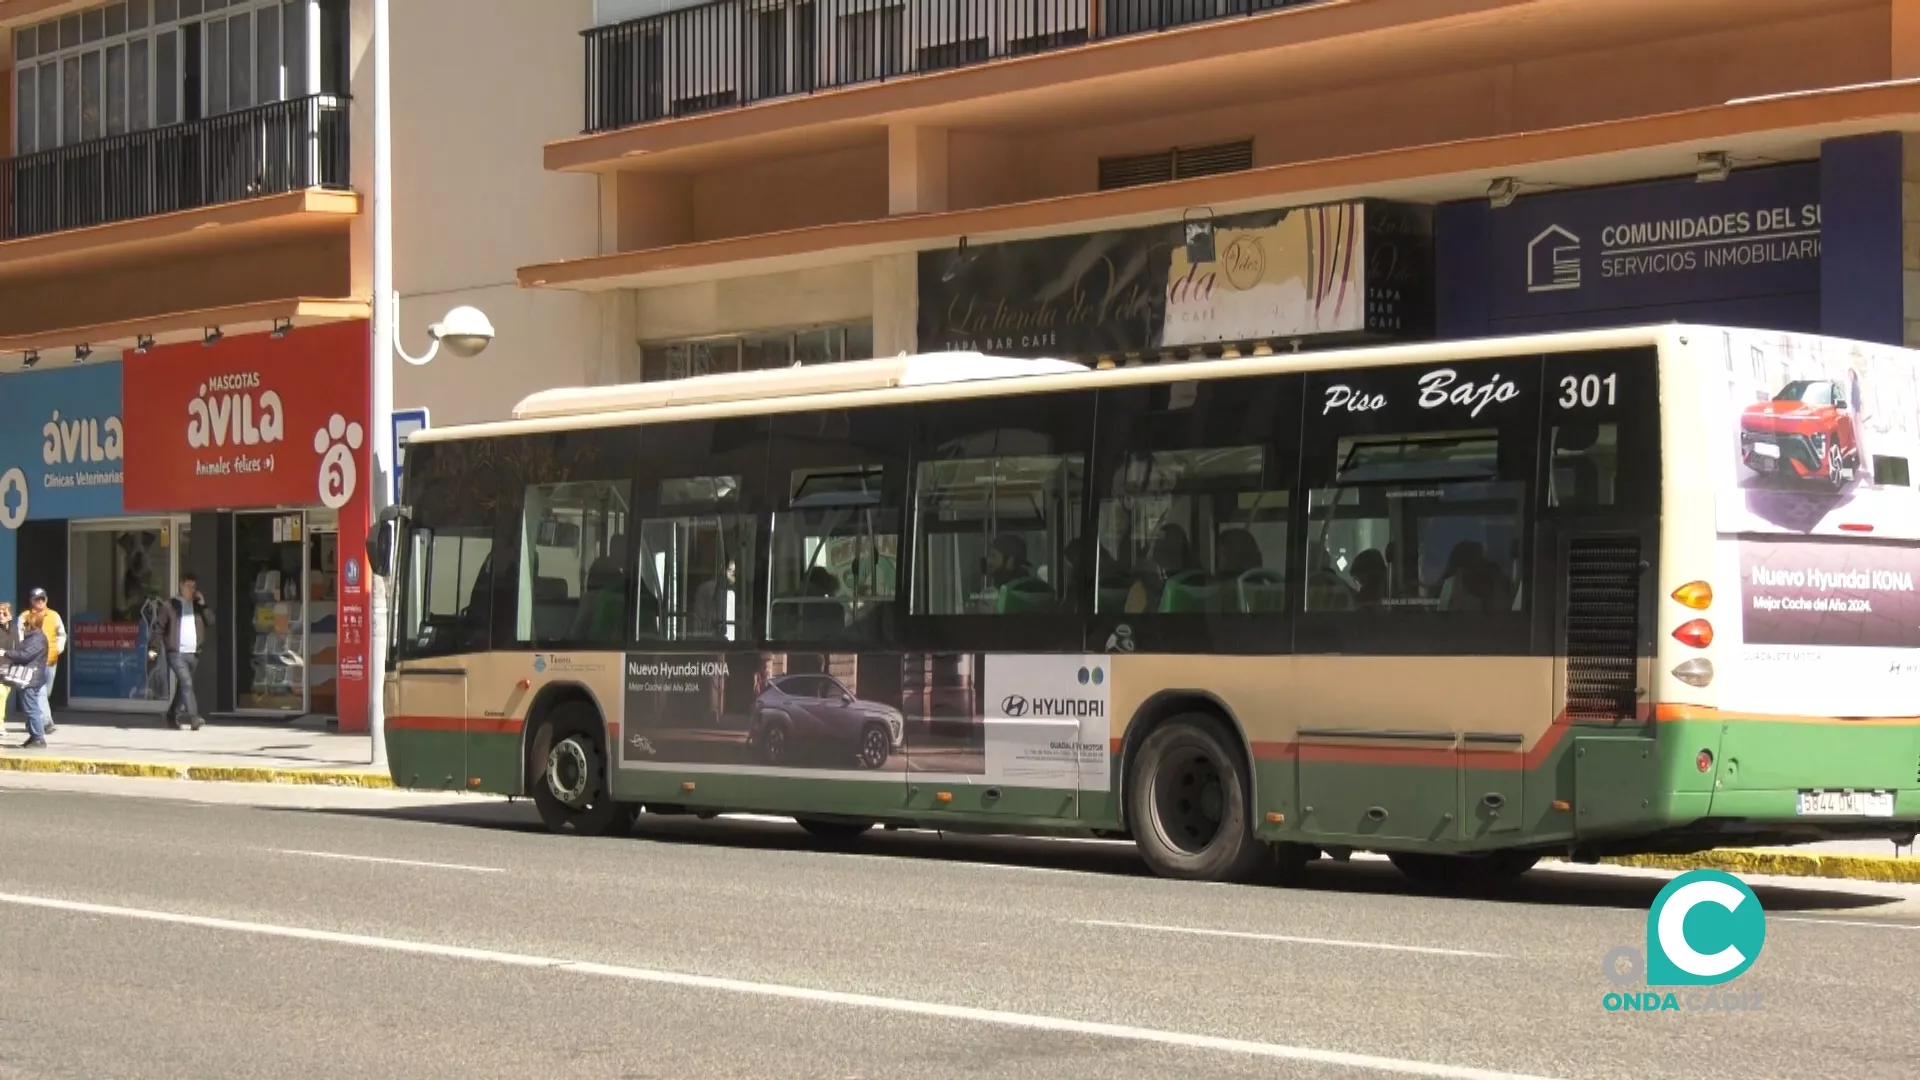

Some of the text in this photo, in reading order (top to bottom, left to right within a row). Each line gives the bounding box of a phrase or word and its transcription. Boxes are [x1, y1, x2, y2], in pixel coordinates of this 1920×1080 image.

[1602, 212, 1750, 247] COMUNIDADES
[1756, 207, 1796, 231] DEL
[1601, 239, 1821, 277] SERVICIOS INMOBILIARI
[987, 337, 1013, 350] BAR
[209, 372, 260, 391] MASCOTAS
[1323, 369, 1617, 418] Piso Bajo 301
[196, 456, 230, 476] Animales
[234, 454, 261, 473] felices
[76, 469, 124, 485] Veterinarias
[1752, 565, 1914, 591] Nuevo Hyundai KONA
[1753, 596, 1780, 611] Mejor
[1781, 597, 1812, 611] Coche
[1813, 598, 1828, 611] del
[1828, 598, 1847, 611] Año
[629, 662, 729, 679] Nuevo Hyundai KONA
[628, 682, 643, 692] Mejor
[645, 682, 662, 692] Coche
[1033, 699, 1104, 717] HYUNDAI
[1804, 795, 1834, 811] 5844
